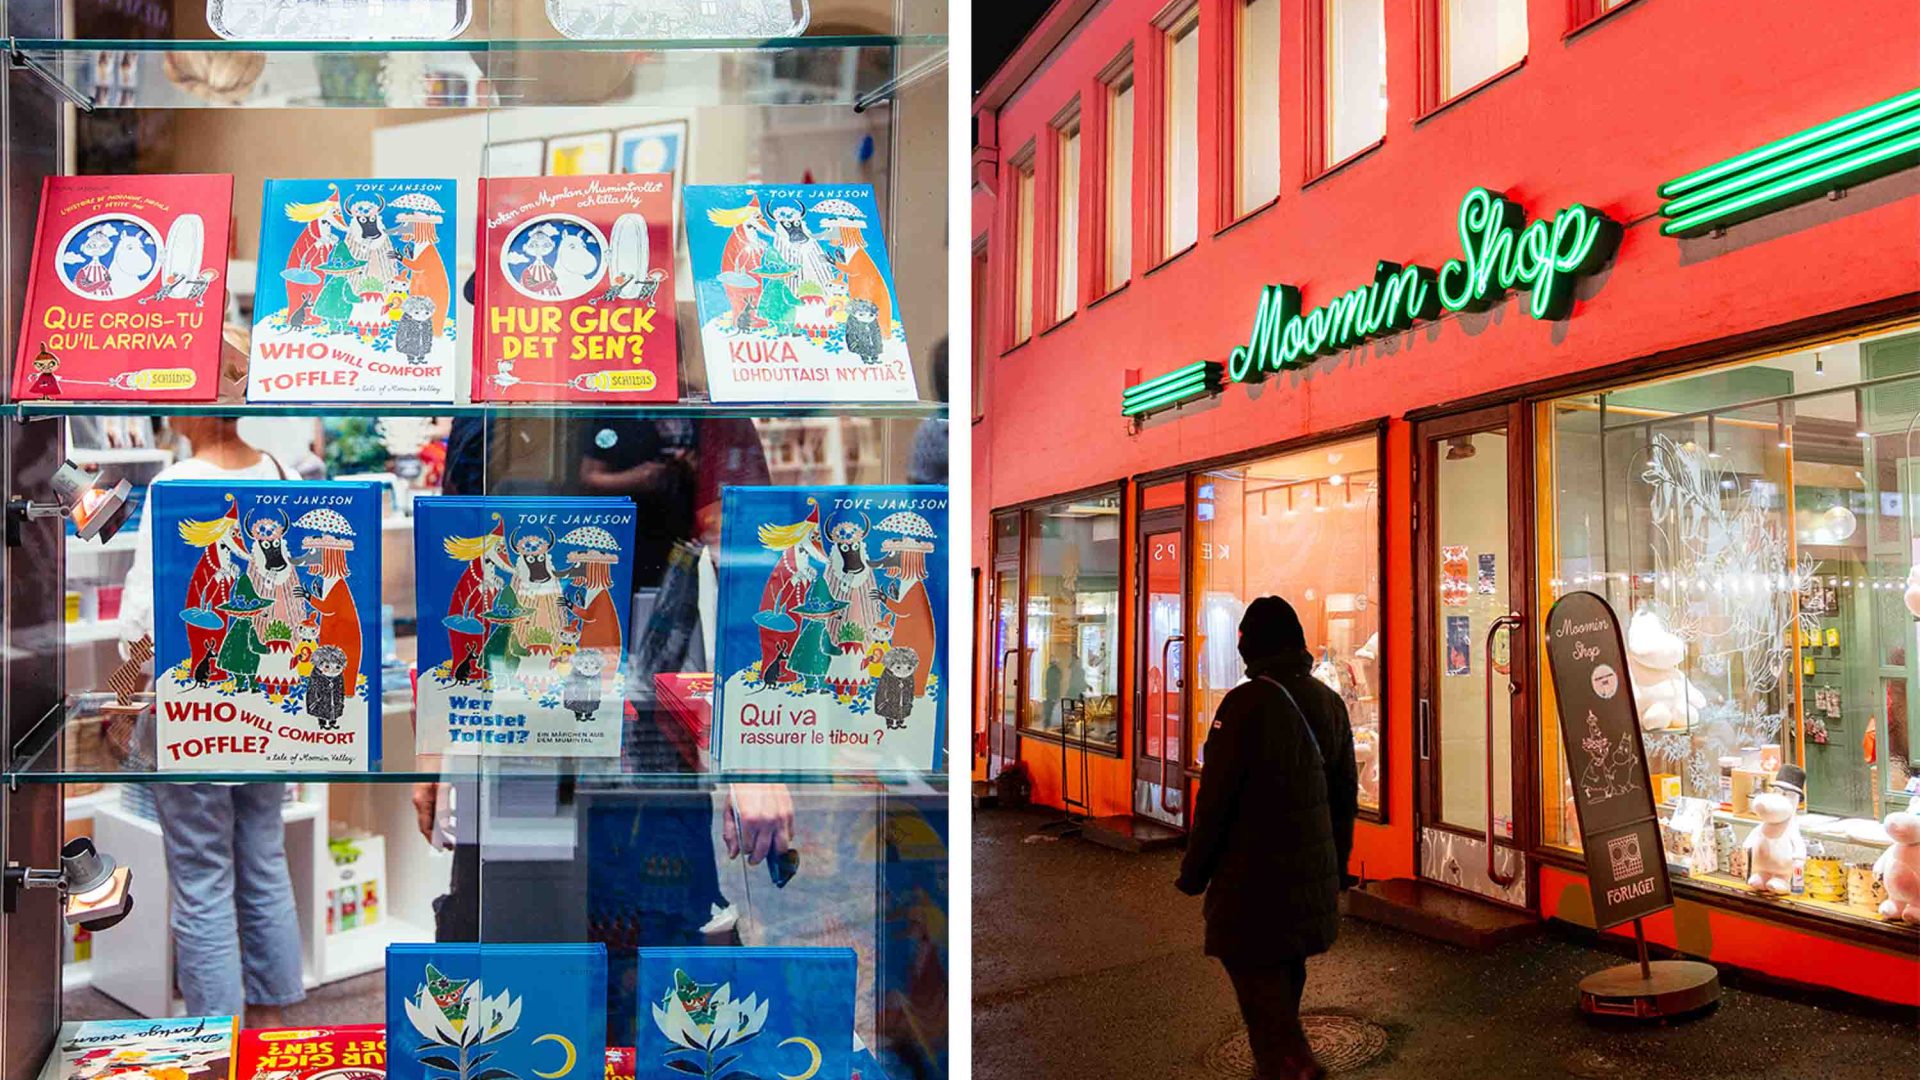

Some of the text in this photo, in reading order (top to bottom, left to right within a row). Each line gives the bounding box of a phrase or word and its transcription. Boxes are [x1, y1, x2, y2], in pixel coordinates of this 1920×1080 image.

[355, 184, 442, 192] TOVE JANSSON
[769, 190, 869, 198] TOVE JANSSON
[577, 194, 642, 208] och lilla My
[488, 207, 519, 229] boken
[520, 203, 535, 213] om
[1228, 186, 1601, 384] Moomin Shop
[44, 306, 204, 330] QUE CROIS-TU
[491, 305, 657, 334] HUR GICK
[48, 333, 99, 350] QU'IL
[103, 333, 177, 350] ARRIVA
[502, 334, 645, 364] DET SEN?
[259, 342, 443, 378] WHO WILL COMFORT
[729, 341, 799, 364] KUKA
[259, 371, 359, 393] TOFFLE?
[733, 361, 906, 382] LOHDUTTAISI NYYTIÄ?
[255, 495, 353, 506] TOVE JANSSON
[834, 499, 947, 510] TOVE JANSSON
[518, 514, 631, 525] TOVE JANSSON
[1556, 618, 1609, 638] Moomin
[1572, 640, 1600, 662] Shop
[449, 696, 493, 711] Wer
[164, 701, 356, 745] WHO WILL COMFORT
[740, 703, 817, 727] Qui va
[740, 731, 807, 745] rassurer
[811, 729, 824, 744] le
[829, 728, 869, 744] tibou
[167, 736, 270, 762] TOFFLE?
[268, 1042, 335, 1055] SEN?
[256, 1053, 335, 1069] GICK
